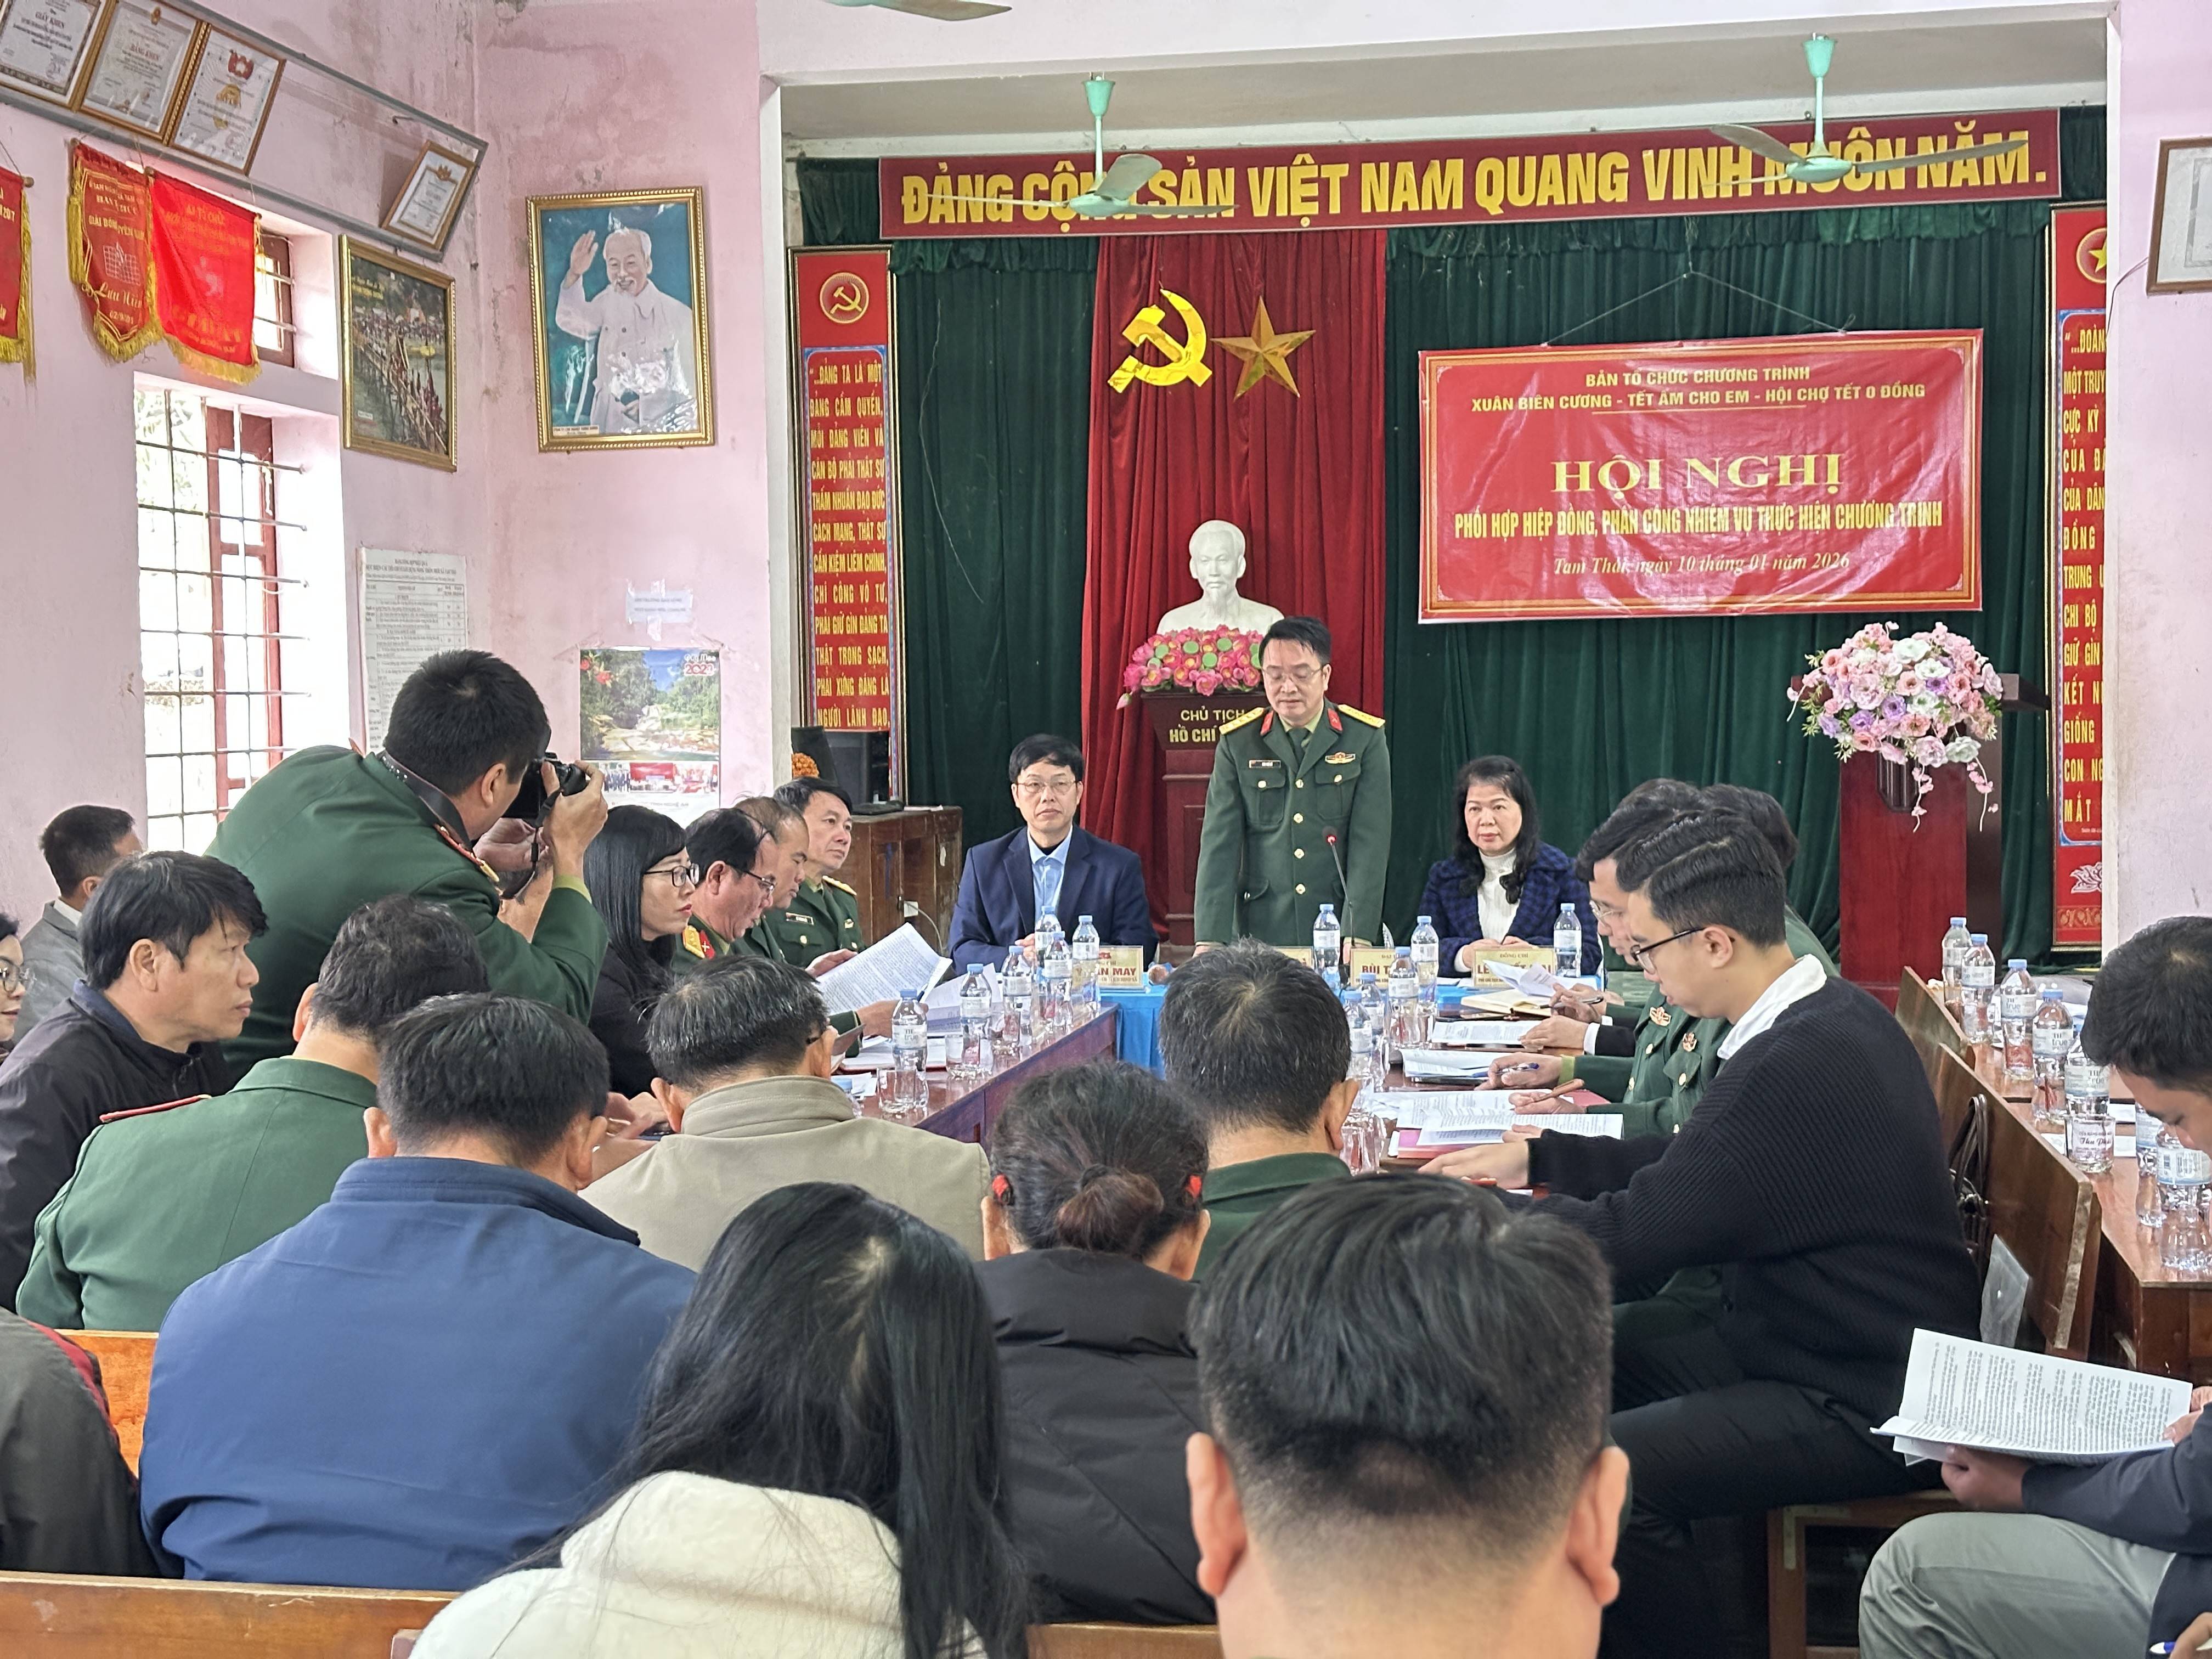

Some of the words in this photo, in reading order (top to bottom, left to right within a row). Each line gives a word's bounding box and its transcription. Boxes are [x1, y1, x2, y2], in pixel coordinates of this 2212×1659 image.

[901, 161, 1014, 224] ĐẢNG
[1023, 160, 1137, 233] CỘ
[1148, 155, 1235, 219] SẢN
[1248, 153, 1349, 228] VIỆT
[1361, 159, 1464, 213] NAM
[1475, 151, 1629, 215] QUANG
[1642, 145, 1753, 201] VINH
[1917, 120, 2046, 188] NĂM.
[842, 364, 851, 383] TA
[855, 360, 864, 383] LÀ
[867, 359, 882, 387] MỘT
[1647, 366, 1689, 386] CHỨC
[1694, 367, 1758, 383] CHƯƠNG
[1763, 364, 1810, 381] TRÌNH
[2063, 365, 2082, 399] MỘT
[810, 390, 830, 417] ĐẢNG
[1471, 396, 1514, 412] XUÂN
[1518, 394, 1554, 410] BIÊN
[1559, 393, 1612, 409] CƯƠNG
[1627, 388, 1654, 407] TẾT
[1689, 391, 1722, 405] CHO
[1725, 390, 1750, 403] EM
[1765, 386, 1792, 405] HỘI
[1797, 386, 1830, 403] CHỢ
[1833, 382, 1862, 400] TẾT
[830, 421, 848, 448] ĐẢNG
[853, 424, 870, 448] VIÊN
[2063, 407, 2080, 439] CỰC
[2087, 404, 2099, 432] KỲ
[828, 456, 837, 483] BỘ
[839, 452, 855, 479] PHẢI
[857, 455, 873, 483] THẬT
[875, 457, 885, 482] SỰ
[2063, 439, 2085, 473] CỦA
[1550, 454, 1664, 499] HỘI
[1686, 453, 1844, 494] NGHỊ
[857, 490, 870, 514] ĐẠO
[2063, 477, 2081, 511] CỦA
[857, 517, 874, 544] THẬT
[877, 520, 887, 545] SỰ
[1492, 509, 1519, 542] HỢP
[1522, 507, 1553, 541] HIỆP
[1602, 505, 1638, 535] PHÂN
[1642, 504, 1680, 534] CÔNG
[1685, 503, 1729, 538] NHIỆM
[1757, 503, 1795, 535] THỰC
[1799, 500, 1831, 535] HIỆN
[1835, 500, 1894, 530] CHƯƠNG
[828, 549, 845, 577] KIỆM
[847, 549, 863, 572] LIÊM
[1554, 557, 1585, 574] Tam
[1678, 555, 1696, 572] 10
[1700, 553, 1743, 575] tháng
[1748, 554, 1767, 569] 01
[1772, 553, 1807, 569] năm
[1811, 552, 1850, 569] 2026
[2064, 565, 2092, 589] TRUNG
[833, 580, 854, 603] CÔNG
[860, 580, 870, 603] VÔ
[815, 607, 830, 635] PHẢI
[833, 611, 845, 634] GIỮ
[859, 607, 878, 634] ĐẢNG
[879, 614, 888, 633] TA
[2064, 603, 2079, 628] CHI
[2085, 599, 2097, 632] BỘ
[816, 643, 833, 669] THẬT
[838, 646, 862, 665] TRONG
[2064, 637, 2079, 667] GIỮ
[2085, 637, 2100, 665] GÌN
[817, 669, 832, 697] PHẢI
[836, 672, 854, 696] XỨNG
[2064, 673, 2084, 705] KẾT
[817, 703, 841, 727] NGƯỜI
[1181, 706, 1208, 721] CHỦ
[1213, 709, 1245, 723] TỊCH
[1169, 724, 1189, 742] HỒ
[1192, 725, 1217, 742] CHÍ
[2064, 758, 2084, 782] CON
[1113, 967, 1137, 976] MAY
[1362, 963, 1380, 974] BÙI
